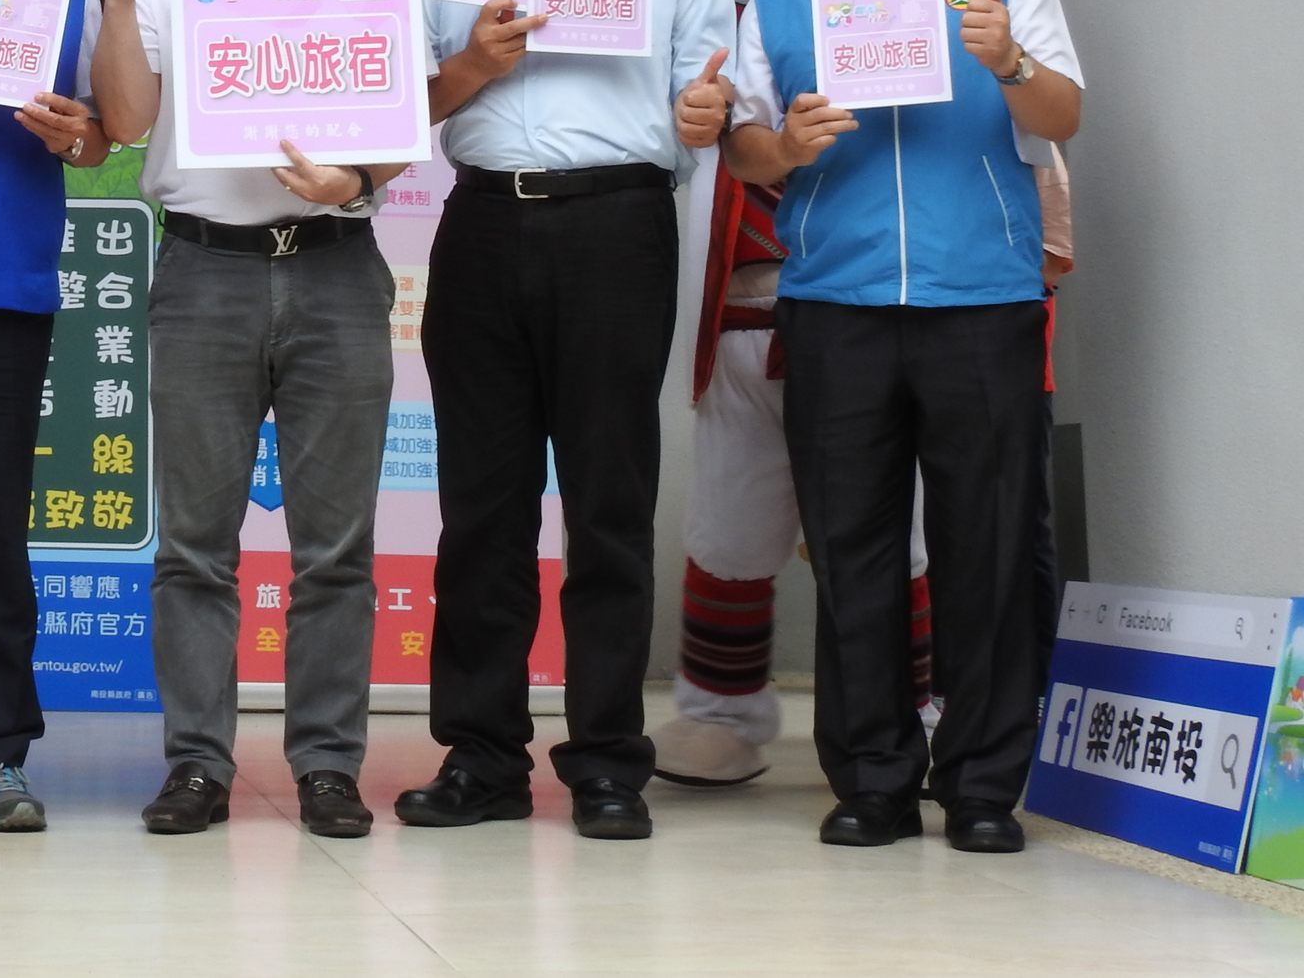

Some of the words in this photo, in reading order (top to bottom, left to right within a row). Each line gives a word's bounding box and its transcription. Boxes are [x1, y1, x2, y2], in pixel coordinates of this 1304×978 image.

[207, 30, 388, 94] 安心旅宿
[833, 38, 929, 73] 安心旅宿
[384, 461, 437, 478] 部加強
[36, 612, 147, 637] 縣府官方
[1119, 607, 1174, 633] Facebook
[1085, 702, 1203, 785] 樂旅南投
